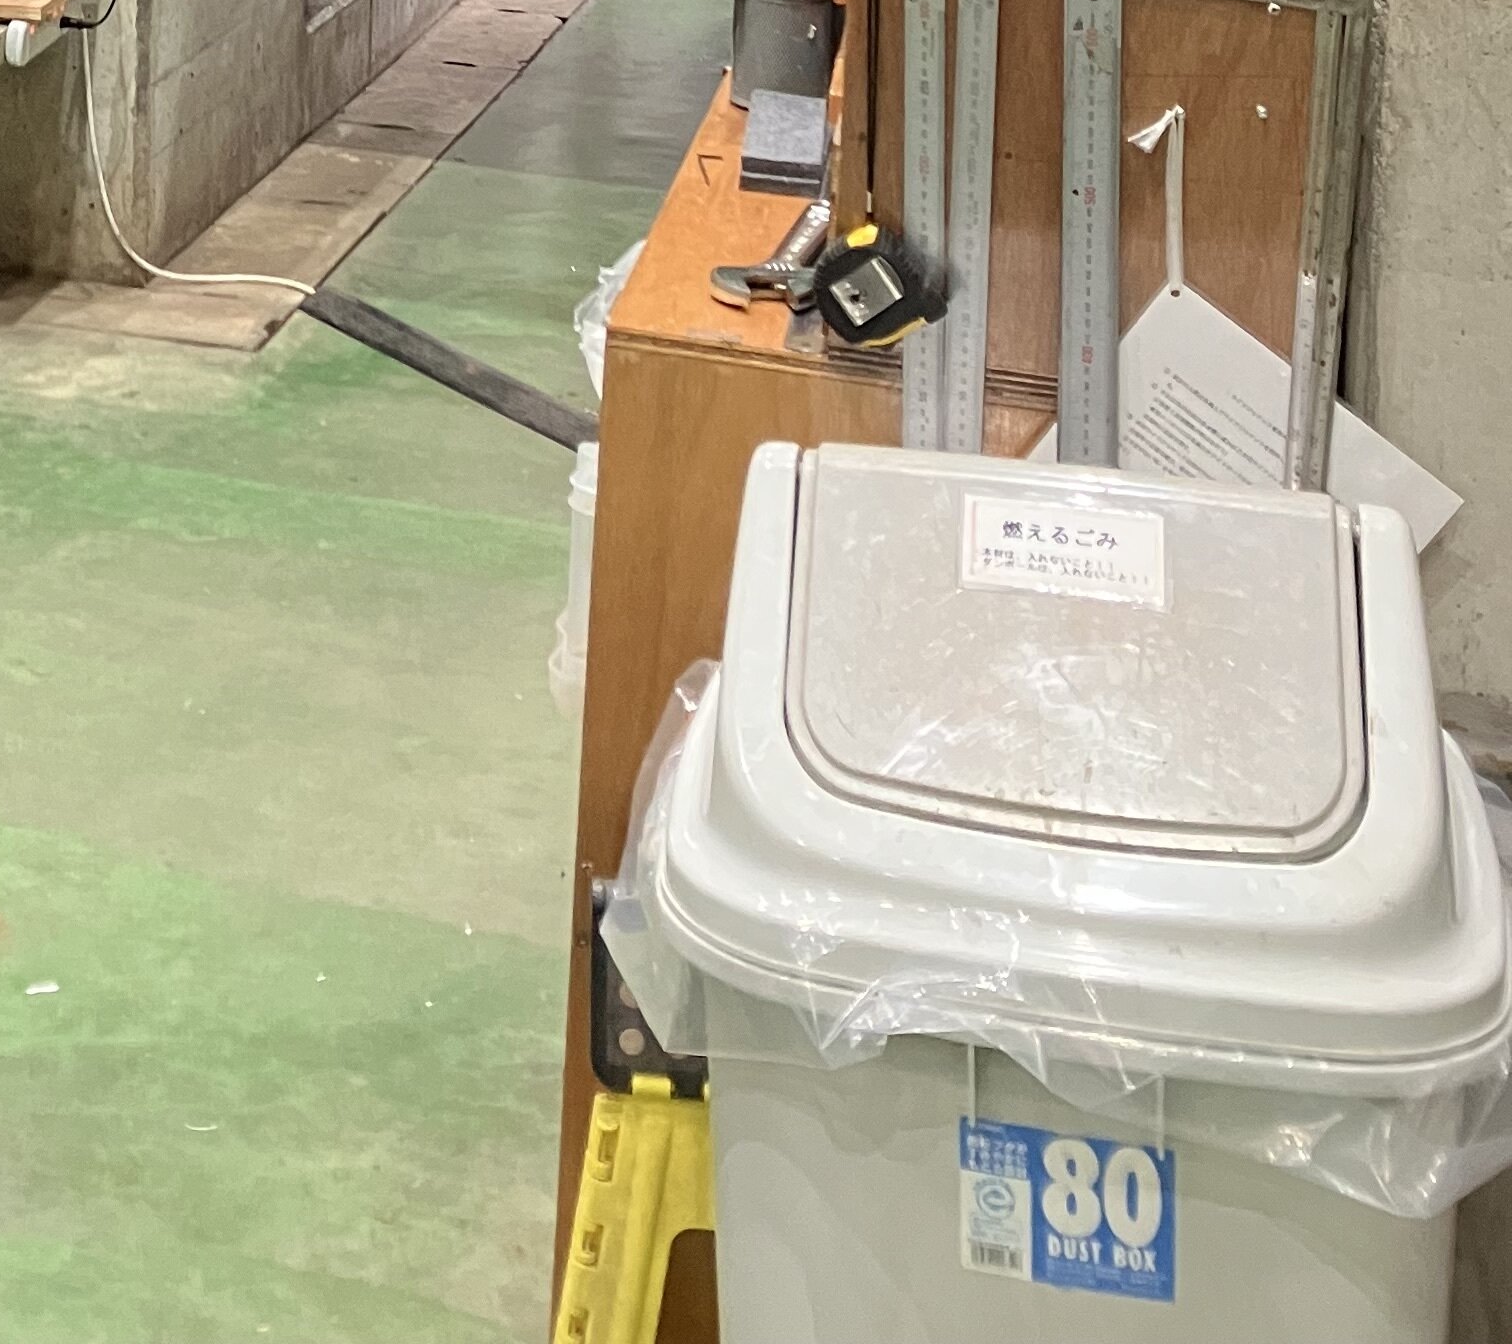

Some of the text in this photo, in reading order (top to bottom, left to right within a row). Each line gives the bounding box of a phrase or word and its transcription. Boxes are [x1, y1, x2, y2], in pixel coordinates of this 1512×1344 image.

[1002, 520, 1119, 550] 燃えるごみ
[1042, 1139, 1163, 1248] 80
[1048, 1233, 1157, 1273] DUST BOX
